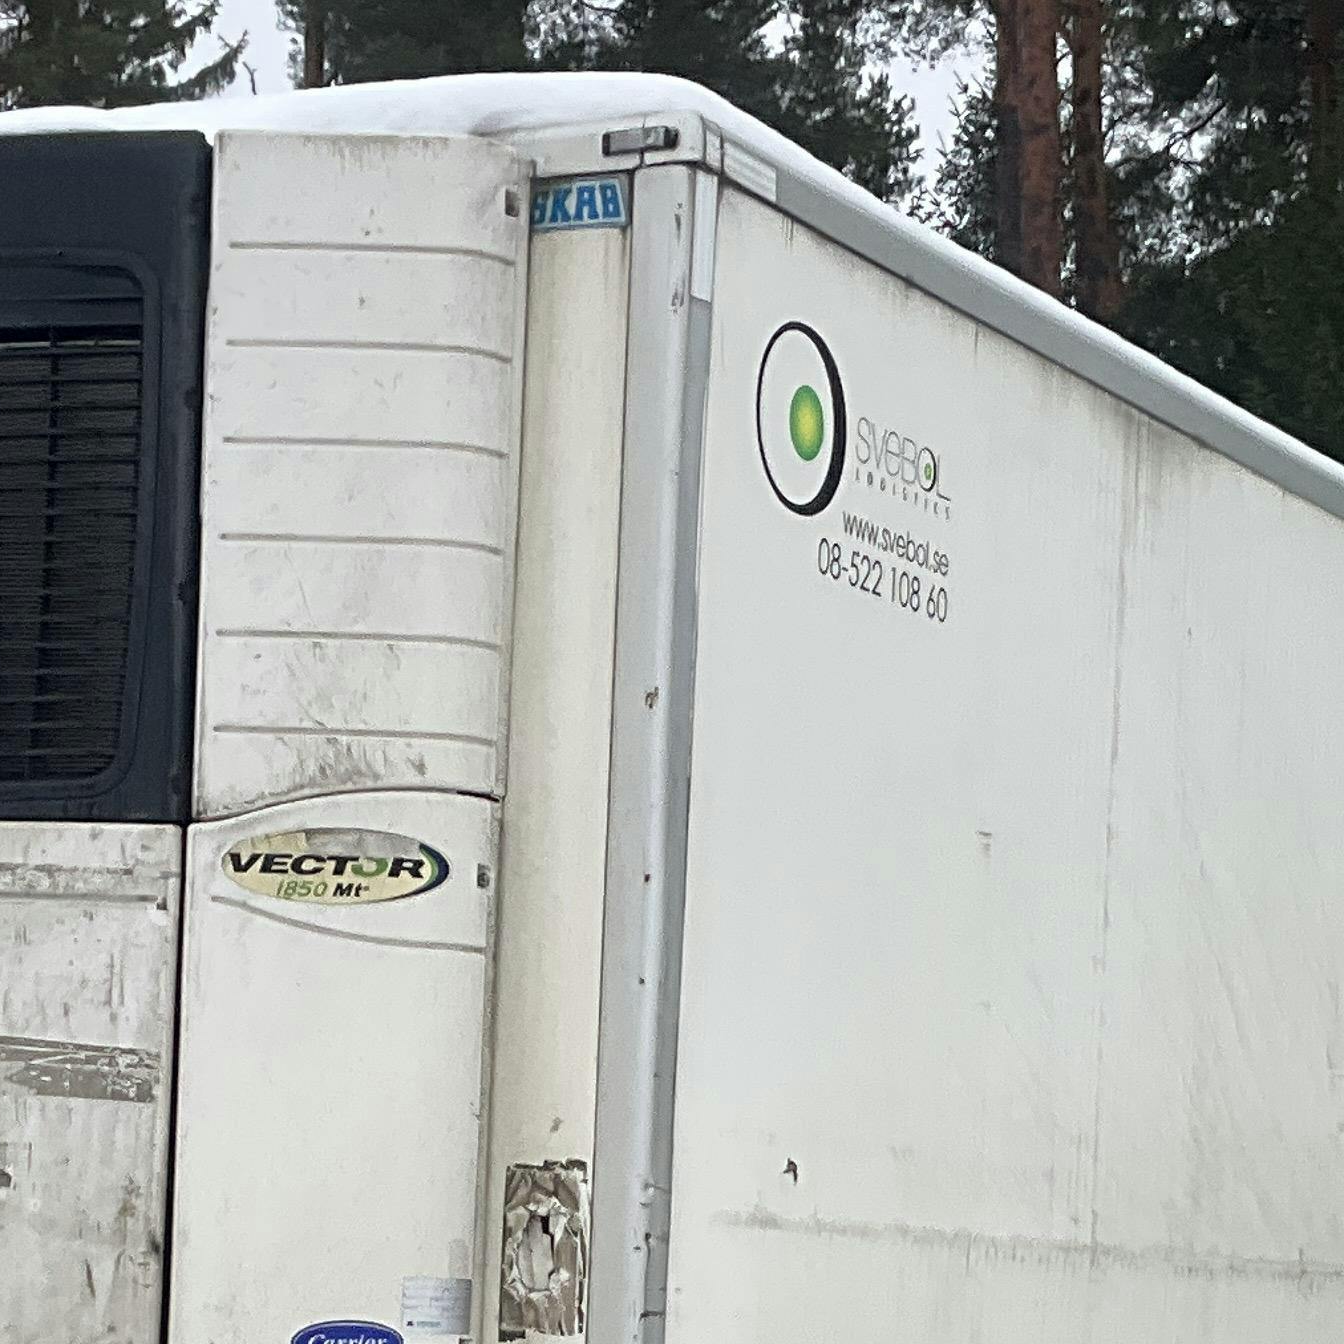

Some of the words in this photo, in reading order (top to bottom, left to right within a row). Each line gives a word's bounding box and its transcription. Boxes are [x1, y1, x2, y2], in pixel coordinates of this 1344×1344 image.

[842, 510, 950, 576] www.svebol.se
[818, 537, 883, 598] 08-522
[890, 566, 921, 612] 108
[926, 584, 948, 623] 60
[228, 852, 425, 879] VECTOR
[275, 879, 327, 898] 1850
